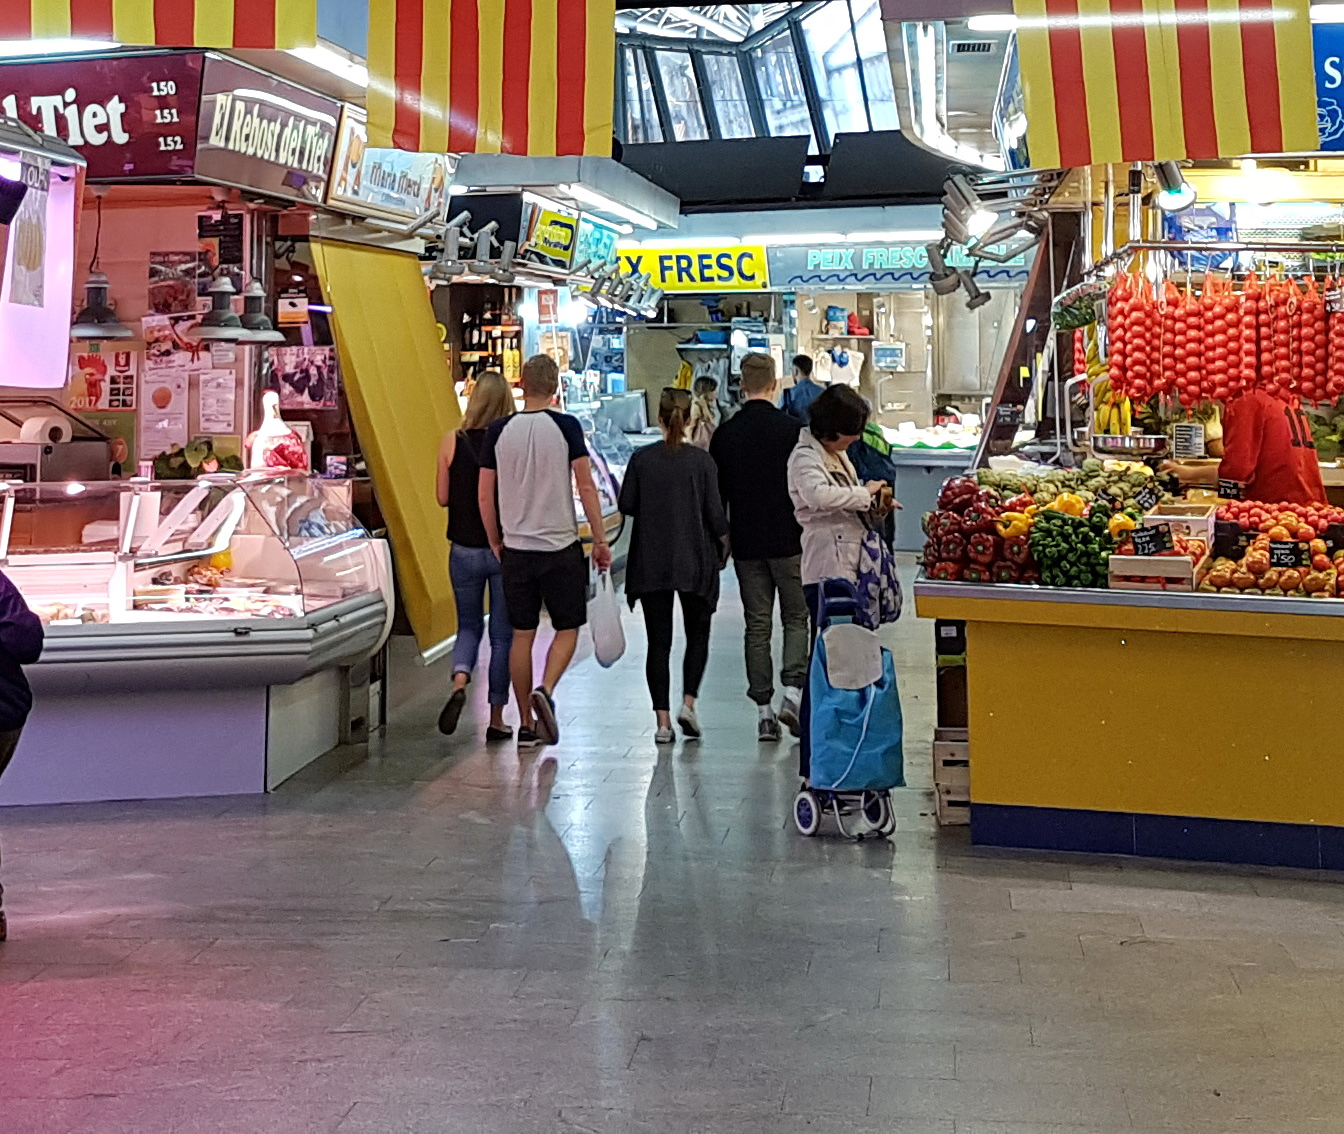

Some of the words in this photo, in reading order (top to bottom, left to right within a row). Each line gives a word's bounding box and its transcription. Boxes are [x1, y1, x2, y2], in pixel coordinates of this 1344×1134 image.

[151, 81, 177, 96] 150
[31, 87, 130, 146] Tiet
[154, 108, 180, 124] 151
[158, 136, 184, 151] 152
[209, 93, 233, 148] El
[228, 99, 282, 162] Rebost
[279, 116, 305, 169] del
[302, 121, 329, 175] Tiet
[658, 252, 756, 284] FRESC
[807, 248, 855, 270] PEIX
[862, 246, 928, 269] FRESC
[70, 397, 97, 408] 2017
